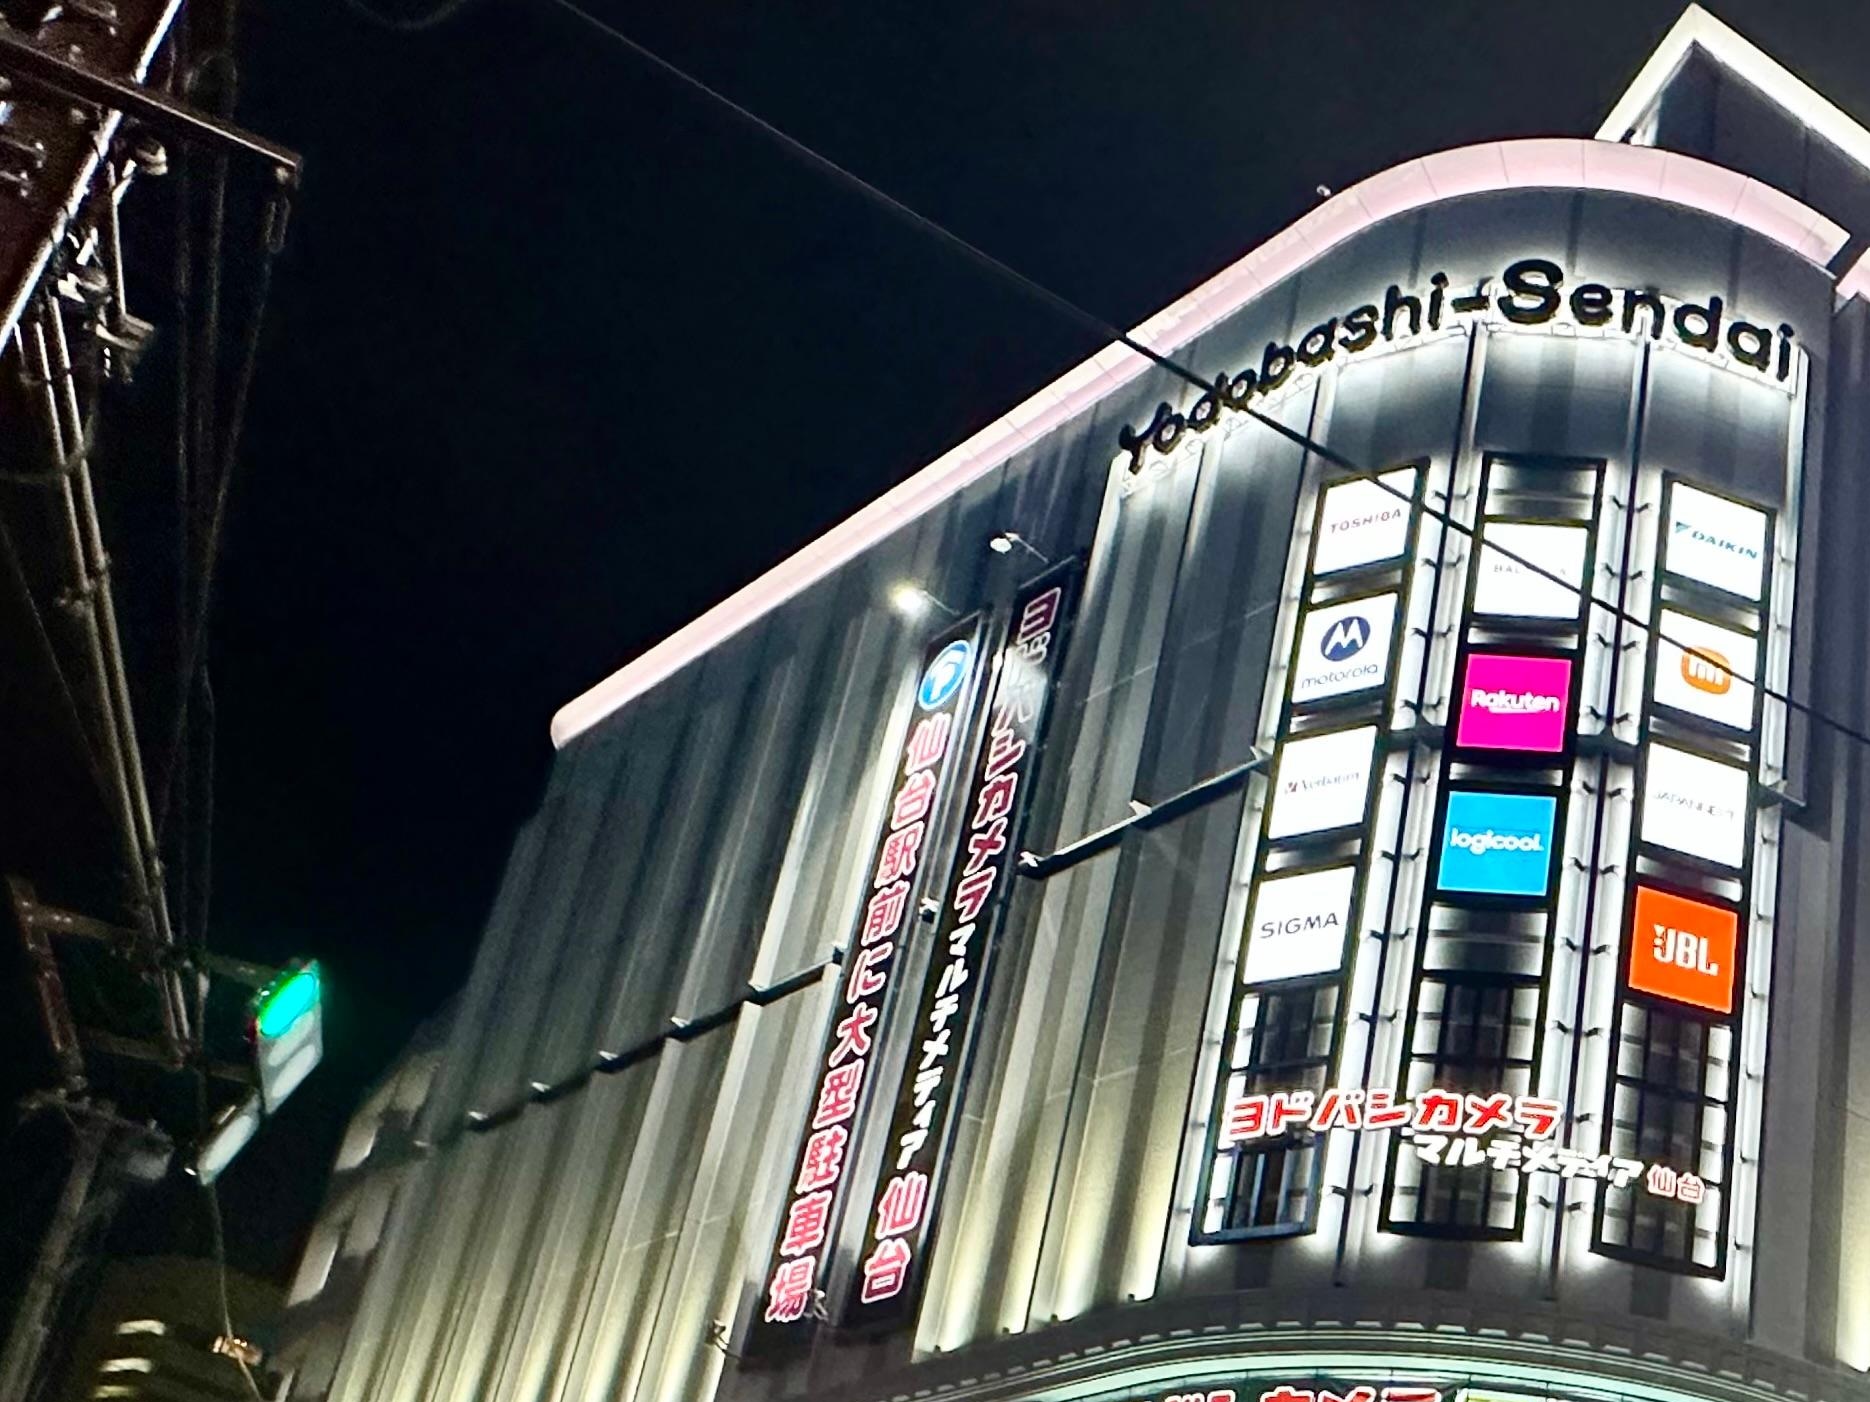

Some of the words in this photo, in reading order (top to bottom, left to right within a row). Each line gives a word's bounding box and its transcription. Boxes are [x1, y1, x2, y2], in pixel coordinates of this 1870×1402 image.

[1118, 259, 1797, 474] Yodobashi-Sendai
[1330, 508, 1402, 534] TOSHIBA
[1692, 531, 1757, 559] DAIKIN
[1301, 664, 1378, 689] motorola
[1471, 688, 1560, 713] Rakuten
[1449, 826, 1543, 856] logicool
[1261, 912, 1339, 939] SIGMA
[1653, 924, 1719, 976] JBL
[766, 711, 951, 1323] 仙台駅前に大型駐車場
[1225, 1087, 1563, 1141] ヨドバシカメラ
